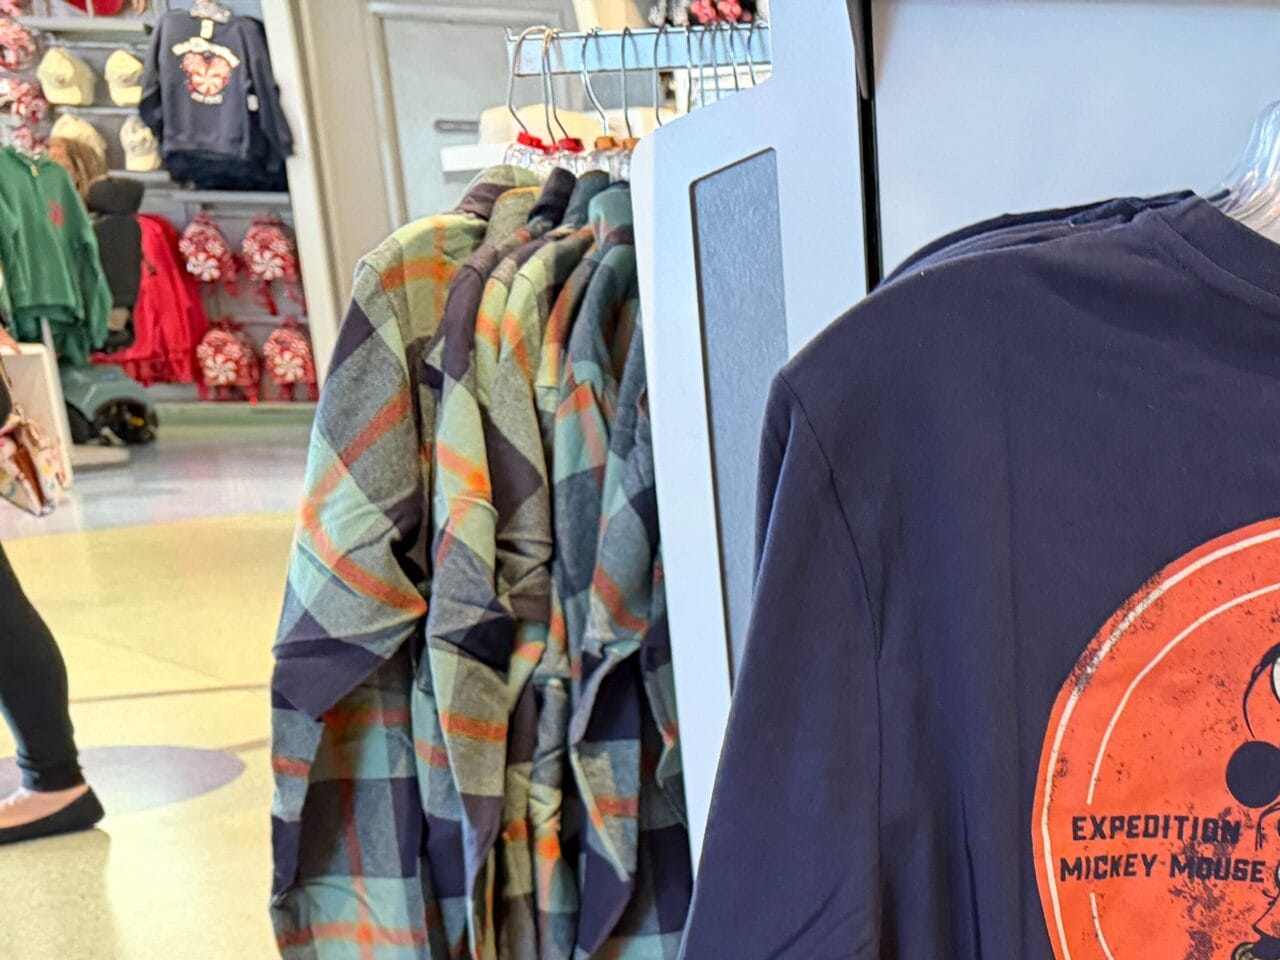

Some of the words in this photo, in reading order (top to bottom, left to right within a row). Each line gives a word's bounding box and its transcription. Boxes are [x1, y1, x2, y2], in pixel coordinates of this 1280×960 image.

[1071, 814, 1241, 844] EXPEDITION
[1060, 853, 1158, 882] MICKEY
[1169, 853, 1267, 883] MOUSE
